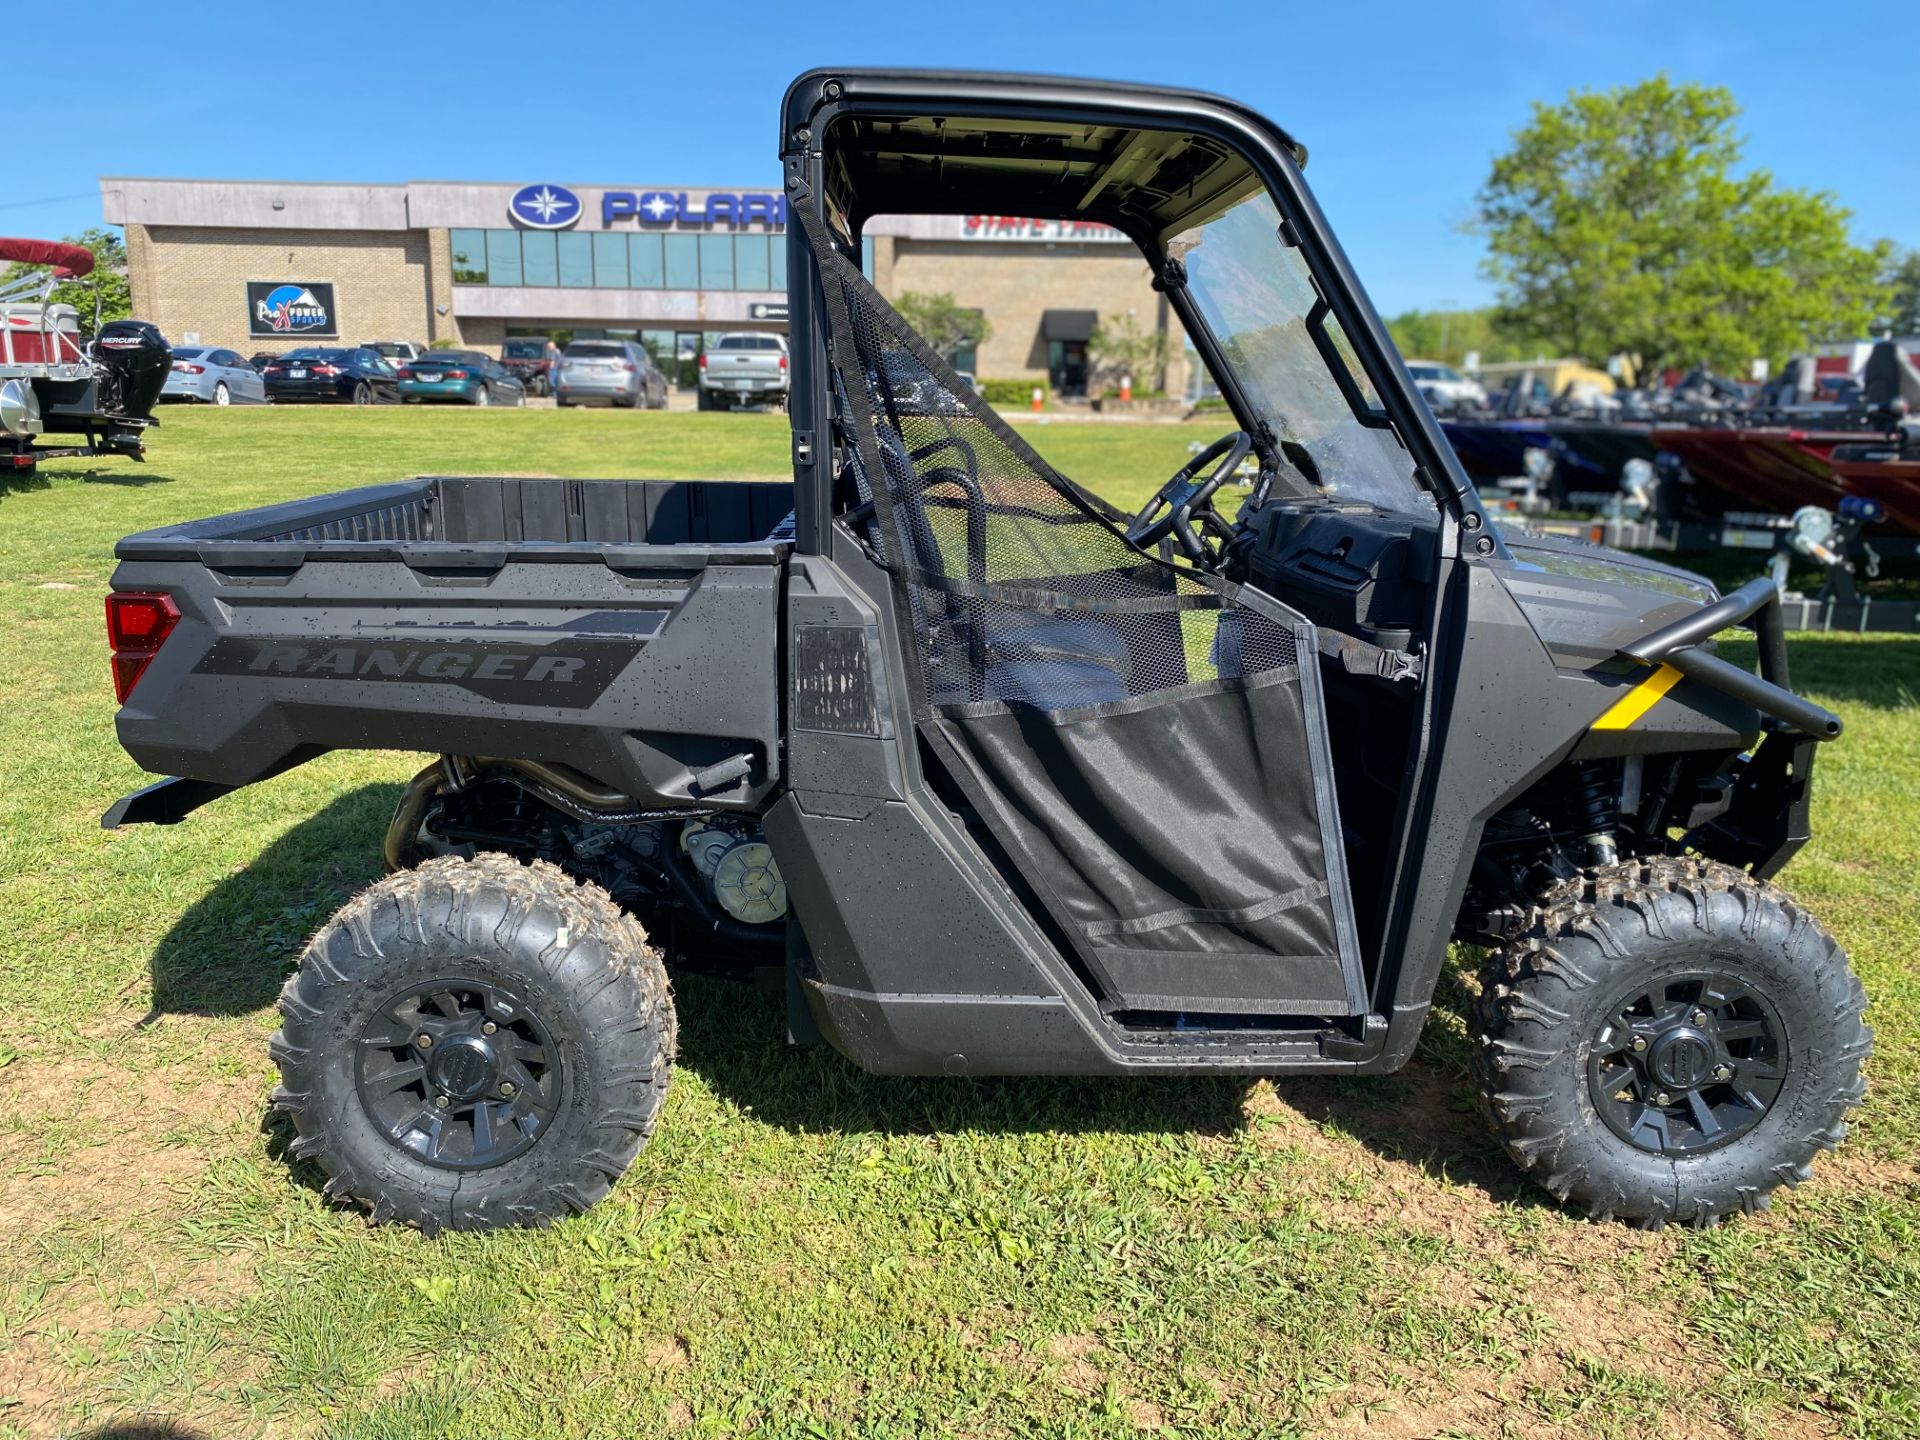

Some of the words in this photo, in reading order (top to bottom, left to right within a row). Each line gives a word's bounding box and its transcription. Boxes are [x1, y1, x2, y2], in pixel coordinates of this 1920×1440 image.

[603, 192, 786, 224] POLARI
[290, 308, 323, 317] POWER
[291, 316, 324, 324] SPORTS
[249, 647, 586, 683] RANGER
